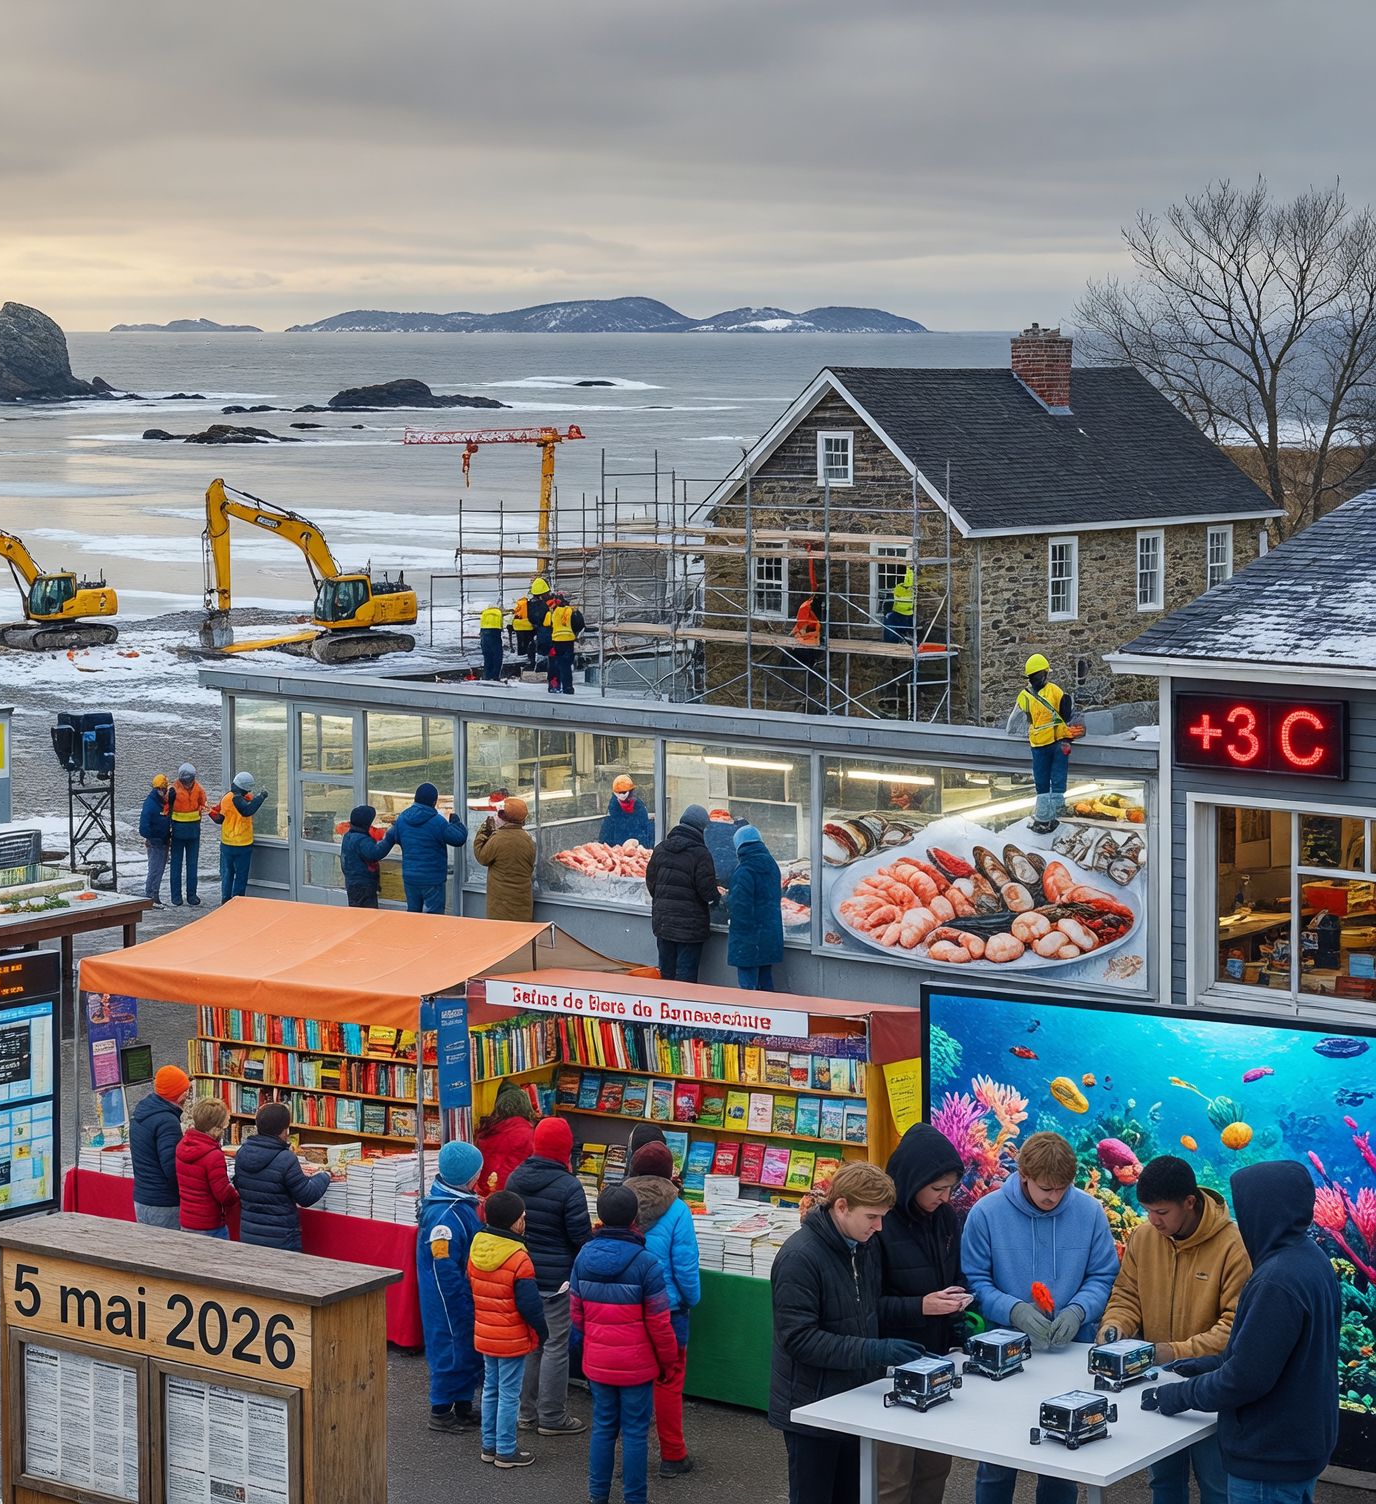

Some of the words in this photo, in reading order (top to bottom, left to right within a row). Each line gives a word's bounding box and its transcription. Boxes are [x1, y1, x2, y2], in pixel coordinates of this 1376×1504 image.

[1190, 707, 1260, 762] +3
[1281, 710, 1325, 766] C
[15, 1263, 41, 1318] 5
[61, 1286, 146, 1340] mai
[166, 1293, 296, 1370] 2026
